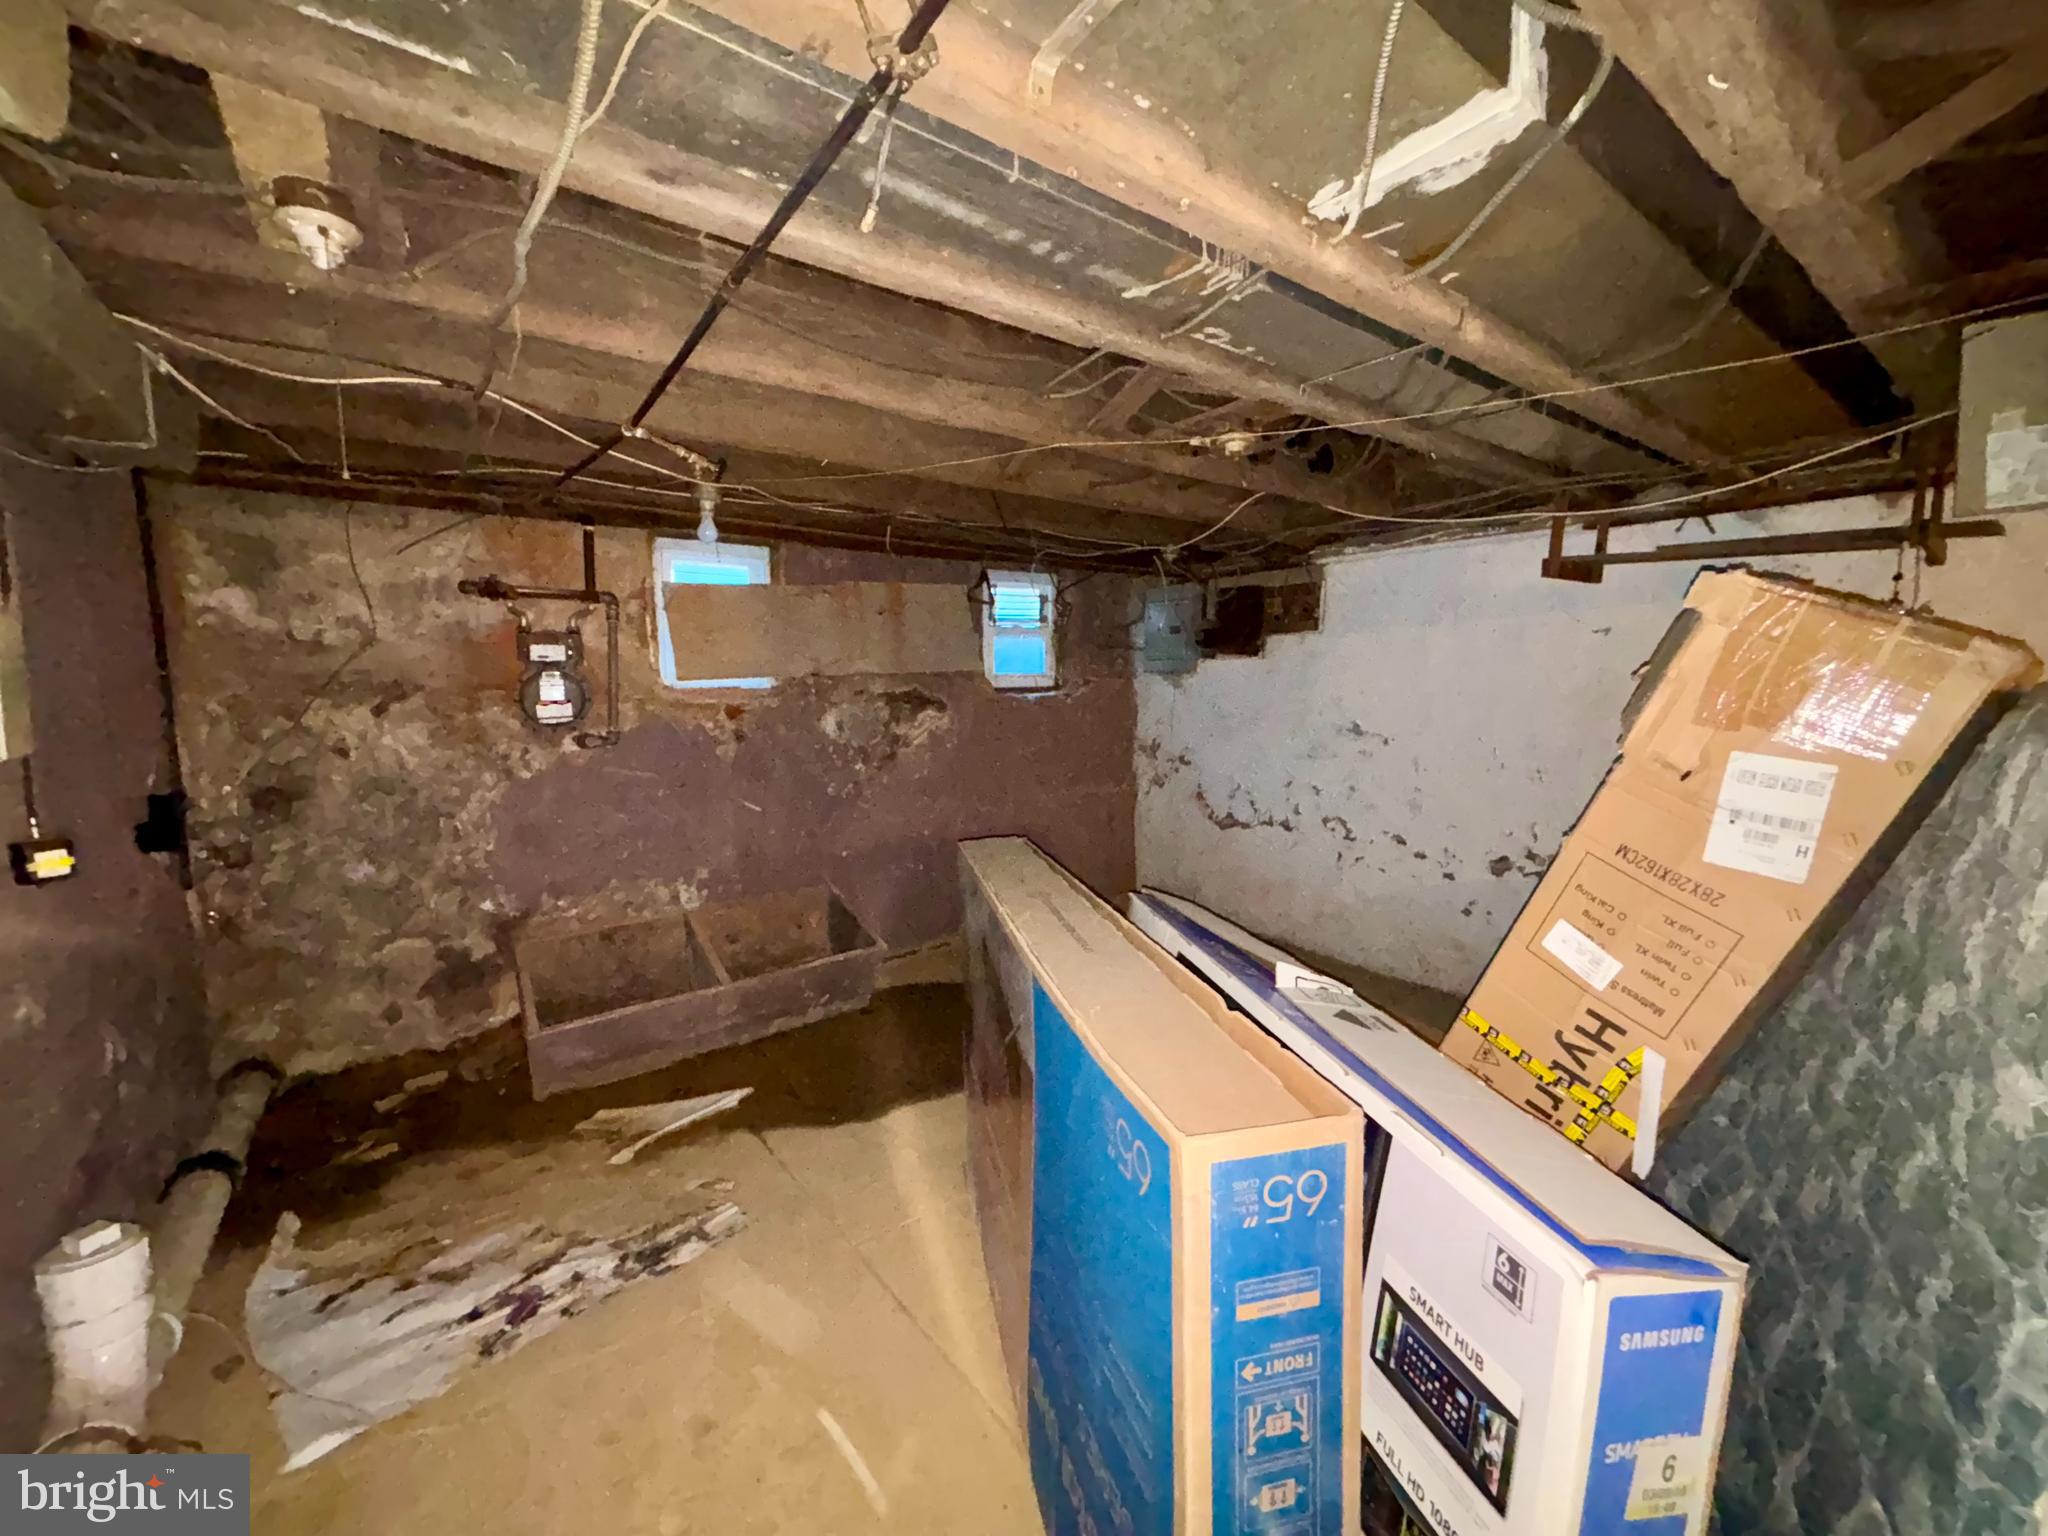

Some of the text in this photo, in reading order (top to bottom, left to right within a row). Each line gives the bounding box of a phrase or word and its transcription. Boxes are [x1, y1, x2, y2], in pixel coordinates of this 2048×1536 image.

[1581, 909, 1606, 930] King
[1635, 943, 1678, 974] Twin XL
[1665, 939, 1691, 957] Full
[1640, 968, 1667, 986] Twin
[1620, 985, 1667, 1018] Mattress
[1497, 1251, 1511, 1274] 6
[1409, 1286, 1484, 1372] SMART HUB
[1619, 1325, 1705, 1351] SAMSUNG
[1265, 1352, 1314, 1377] FRONT
[1376, 1430, 1404, 1478] FULL
[1406, 1470, 1425, 1502] HD
[1662, 1454, 1678, 1483] 6
